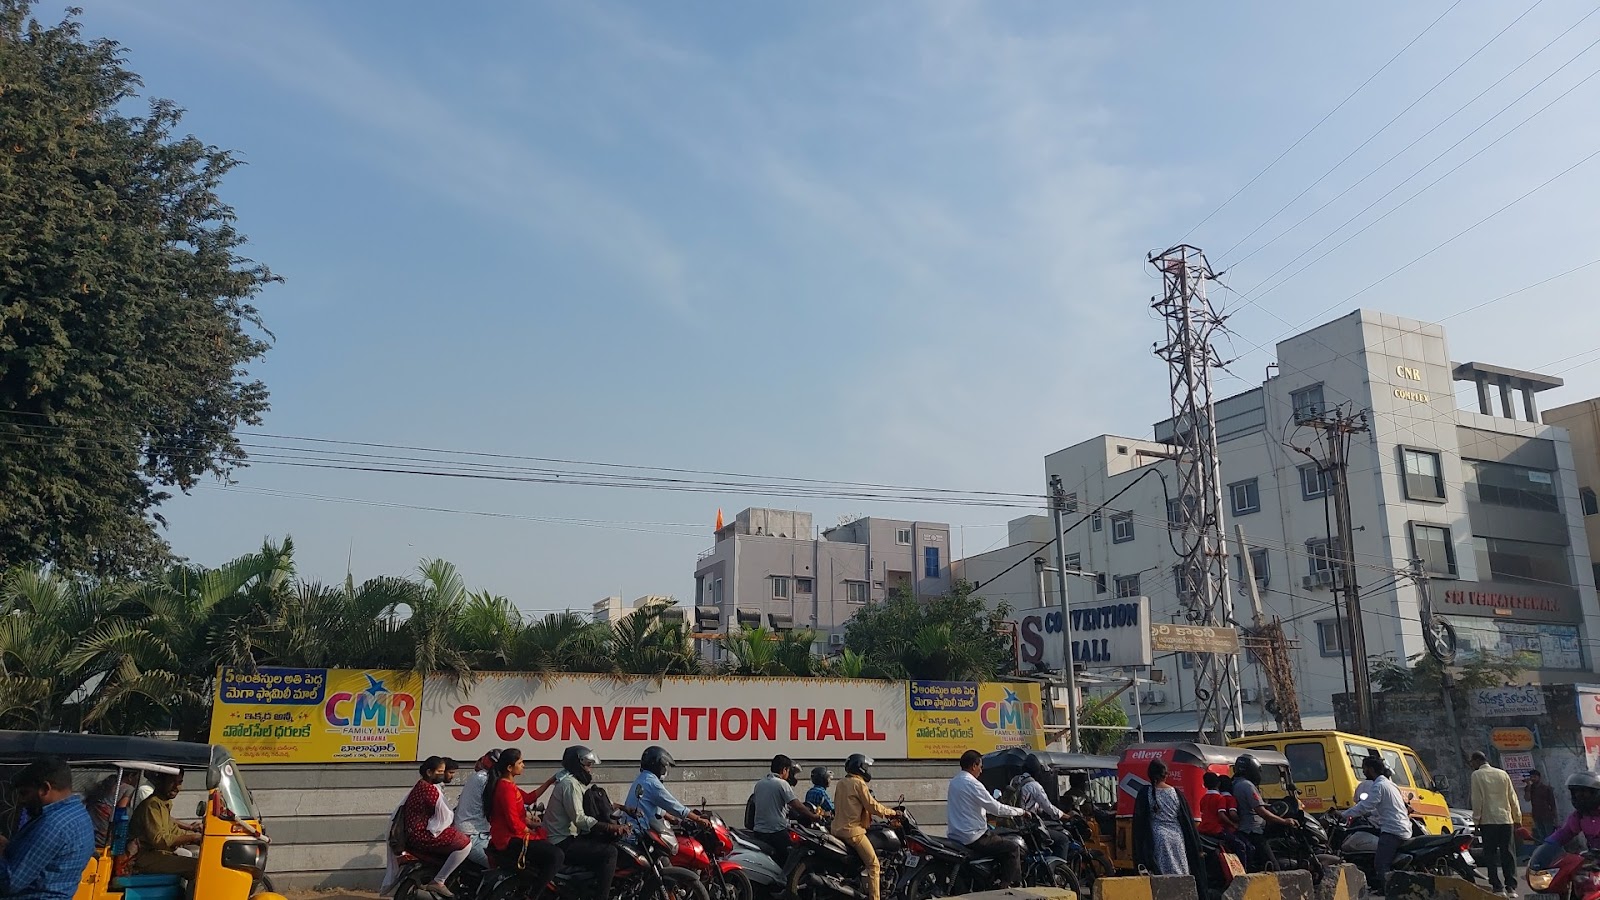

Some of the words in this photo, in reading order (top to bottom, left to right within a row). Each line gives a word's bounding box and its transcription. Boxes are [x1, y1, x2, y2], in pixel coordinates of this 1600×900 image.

[1395, 365, 1420, 381] CNR
[1393, 389, 1429, 404] COMPLEX
[1445, 590, 1464, 605] SRI
[1021, 615, 1044, 664] S
[1045, 603, 1138, 634] COVENTION
[225, 687, 255, 699] మెగా
[293, 687, 318, 699] మాల్
[911, 682, 918, 694] 5
[325, 692, 416, 728] CMR
[980, 701, 1042, 730] CMR
[451, 705, 481, 742] S
[495, 705, 777, 741] CONVENTION
[789, 707, 886, 741] HALL
[340, 743, 396, 754] బాలాపూర్
